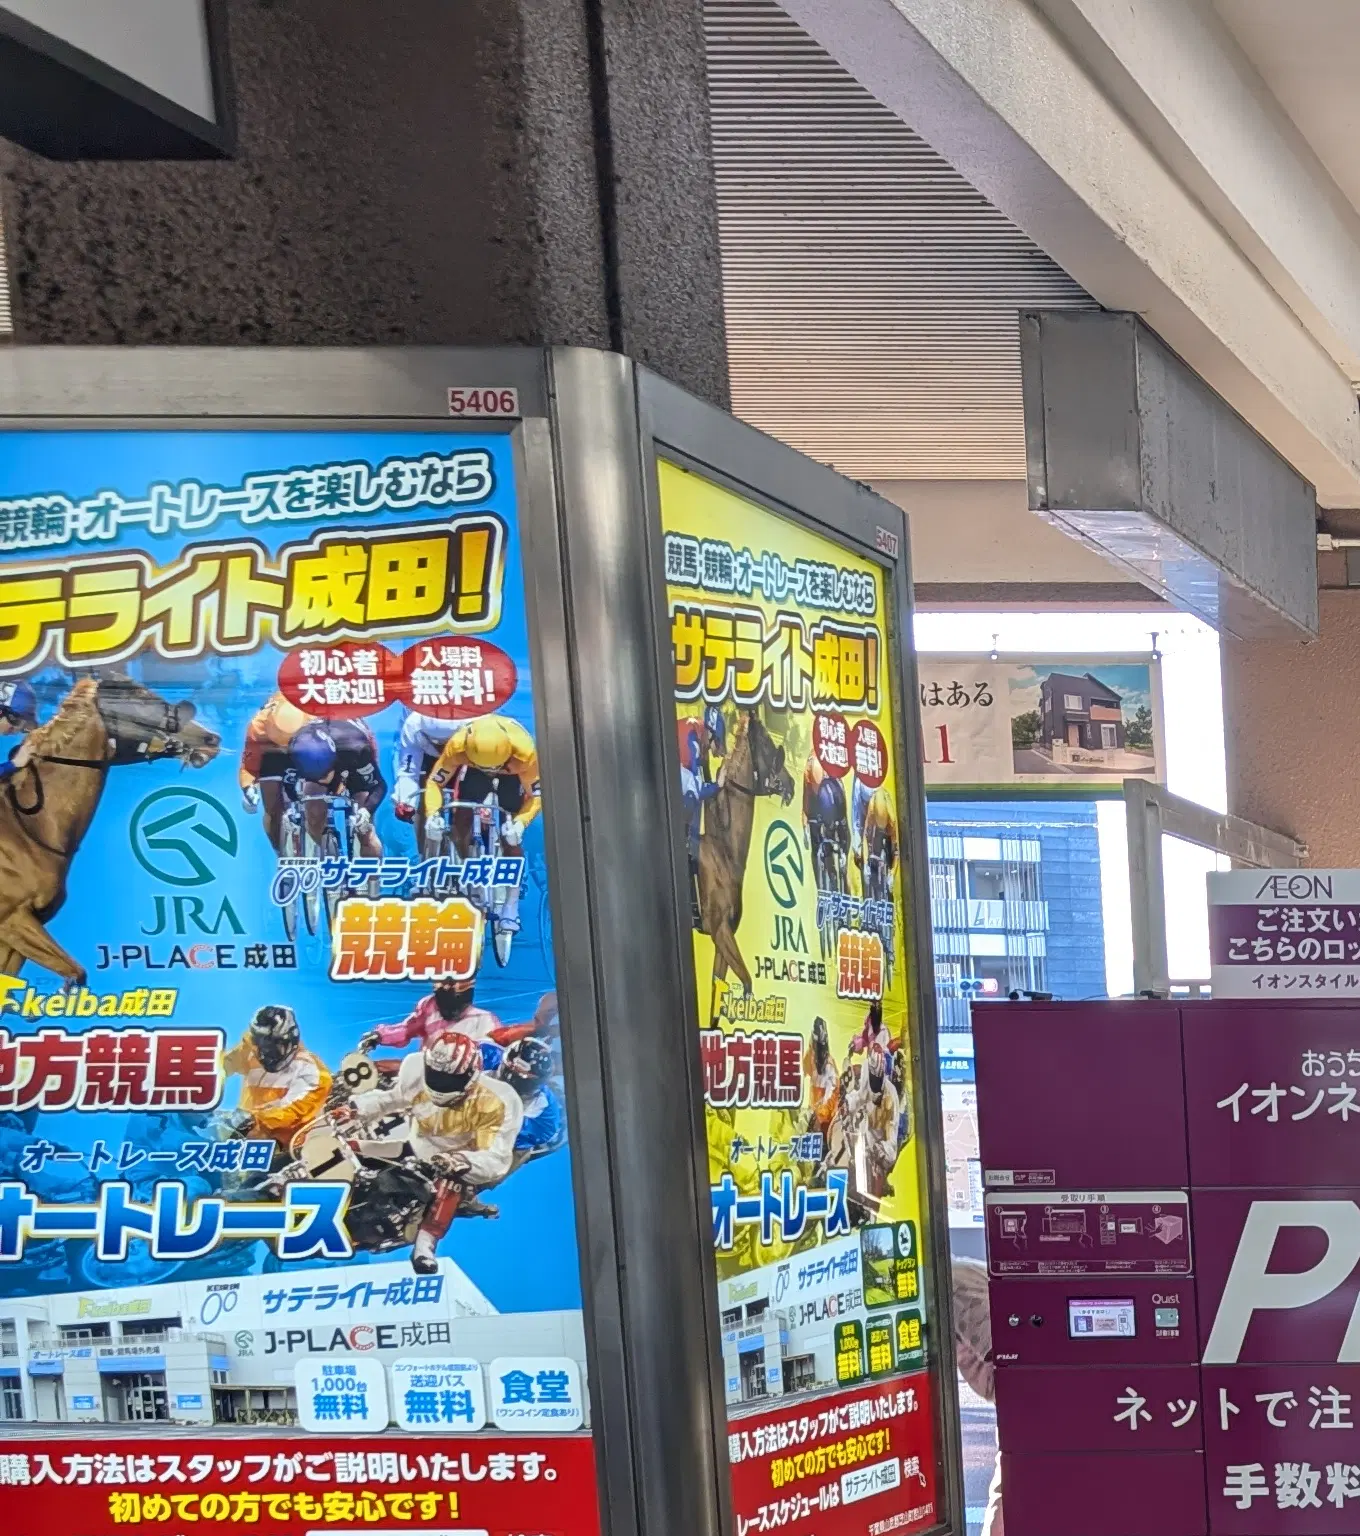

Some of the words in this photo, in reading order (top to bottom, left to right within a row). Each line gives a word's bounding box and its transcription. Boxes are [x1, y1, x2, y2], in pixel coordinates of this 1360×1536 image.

[449, 390, 515, 414] 5406
[667, 540, 874, 608] 競馬・競輪・オートレースを楽しむなら
[299, 648, 379, 676] 初心者
[420, 646, 483, 668] 入場料
[672, 613, 877, 704] サテライト成田!
[297, 678, 385, 704] 大歓迎!
[410, 668, 496, 706] 無料!
[923, 723, 956, 764] 1
[320, 857, 525, 888] サテライト成田
[1255, 874, 1333, 900] AEON
[140, 895, 246, 936] JRA
[337, 901, 475, 975] 競輪
[770, 914, 809, 955] JRA
[839, 931, 883, 994] 競輪
[0, 1034, 217, 1106] 方競馬
[701, 1035, 802, 1104] 地方競馬
[22, 1139, 277, 1172] オートレース成田
[731, 1132, 824, 1162] オートレース成田
[711, 1170, 849, 1244] オートレース
[262, 1275, 445, 1315] サテライト成田
[311, 1377, 368, 1393] 1,000台
[321, 1365, 357, 1377] 駐車場
[410, 1374, 466, 1388] 送迎バス
[500, 1369, 572, 1404] 食堂
[313, 1393, 369, 1421] 無料
[404, 1389, 476, 1423] 無料
[728, 1388, 918, 1463] 購入方法はスタッフがご説明いたします。
[0, 1452, 557, 1486] 購入方法はスタッフがご説明いたします。
[771, 1428, 891, 1488] 初めての方でも安心です!
[845, 1462, 897, 1496] サテライト成田
[109, 1491, 460, 1523] 初めての方でも安心です!
